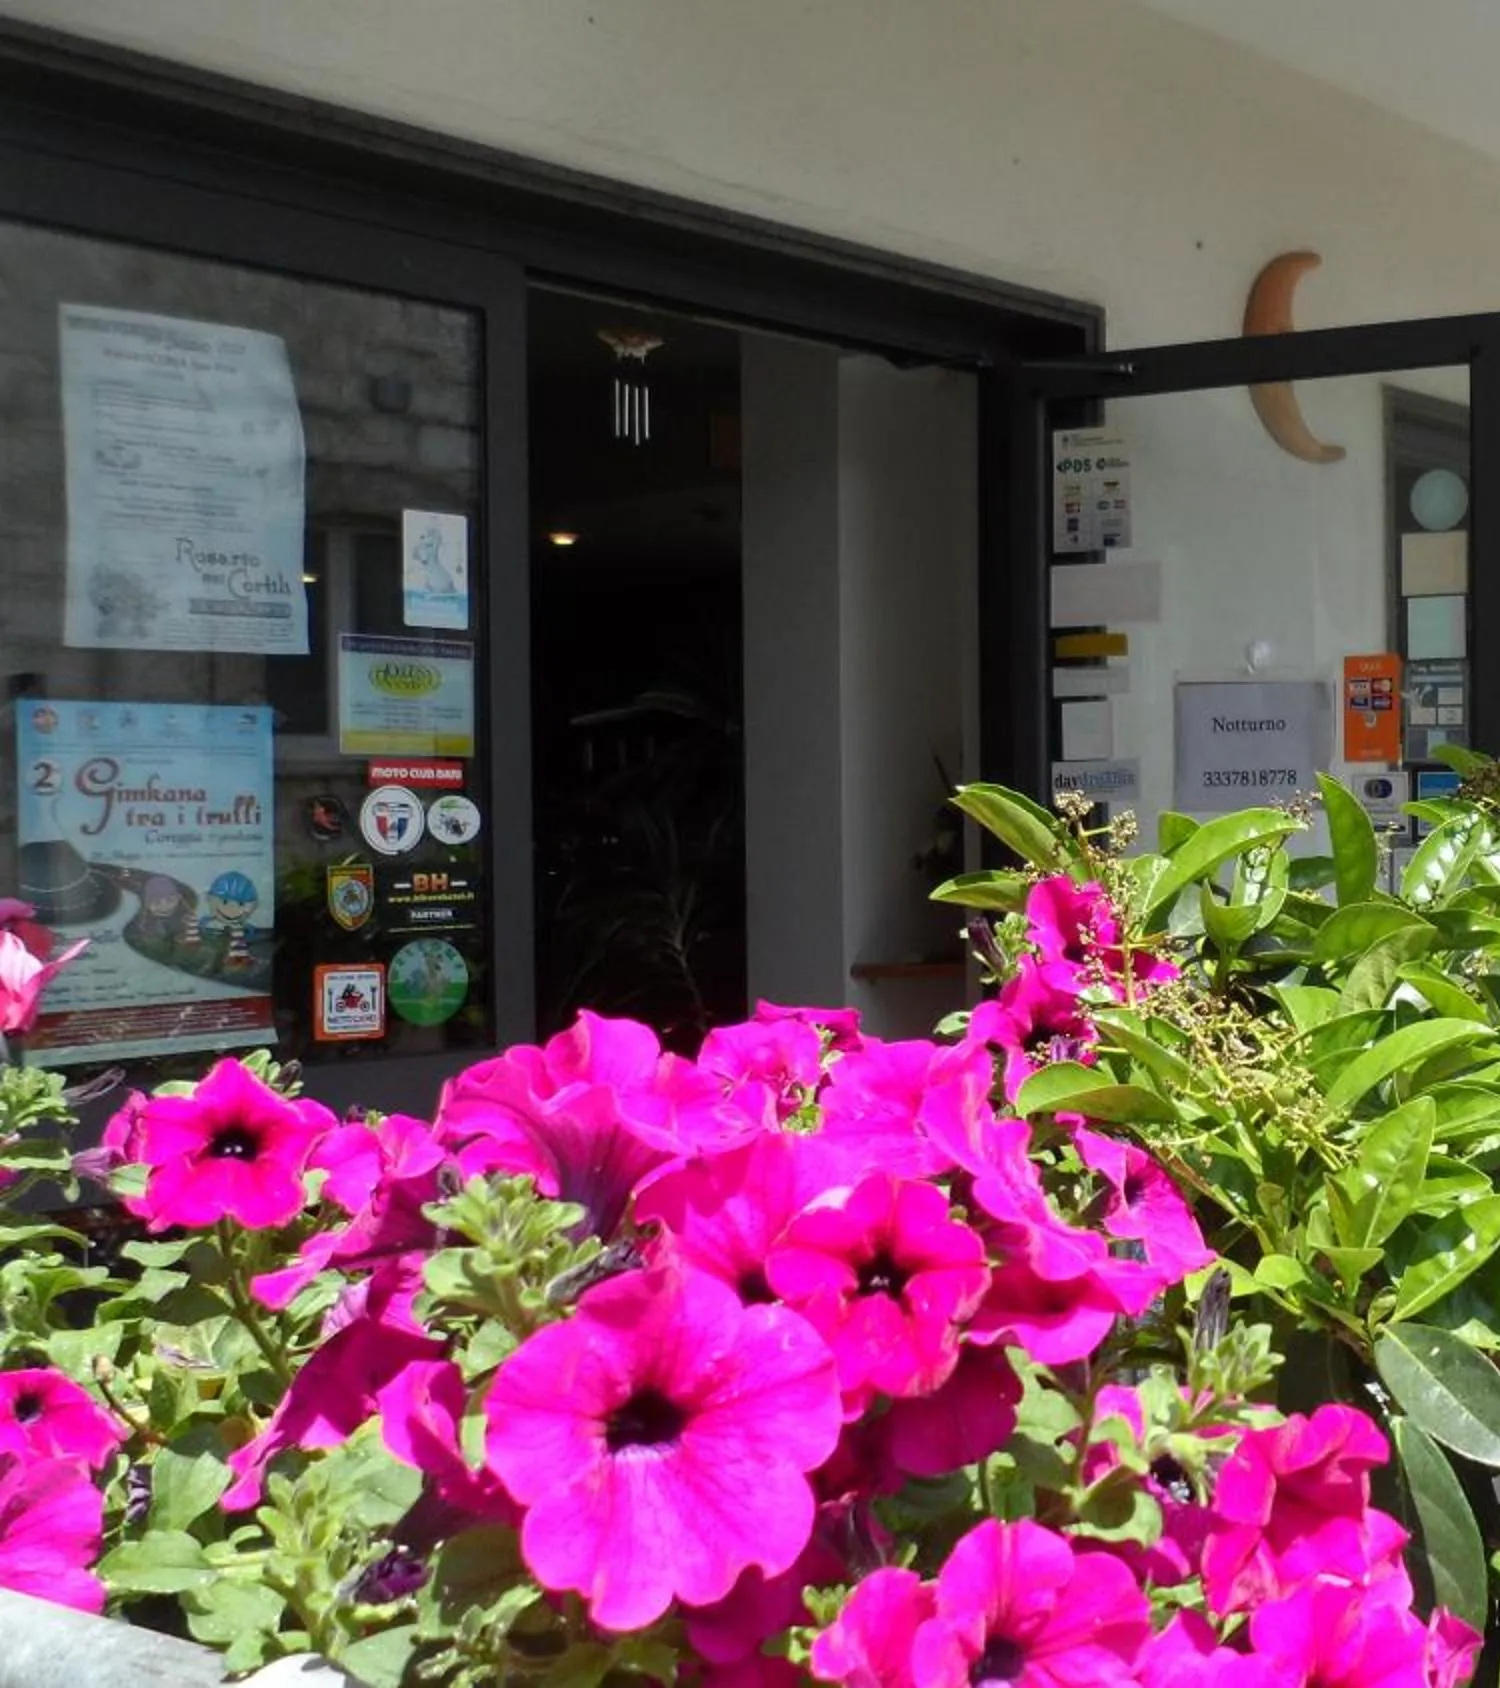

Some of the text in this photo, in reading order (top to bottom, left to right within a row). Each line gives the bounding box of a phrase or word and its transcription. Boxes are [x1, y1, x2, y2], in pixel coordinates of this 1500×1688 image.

[1211, 716, 1287, 733] Notturno
[371, 767, 408, 779] MOTO
[34, 756, 207, 835] 2 Gimkana
[125, 807, 166, 827] tra
[196, 793, 262, 825] trulli
[413, 873, 449, 892] BH
